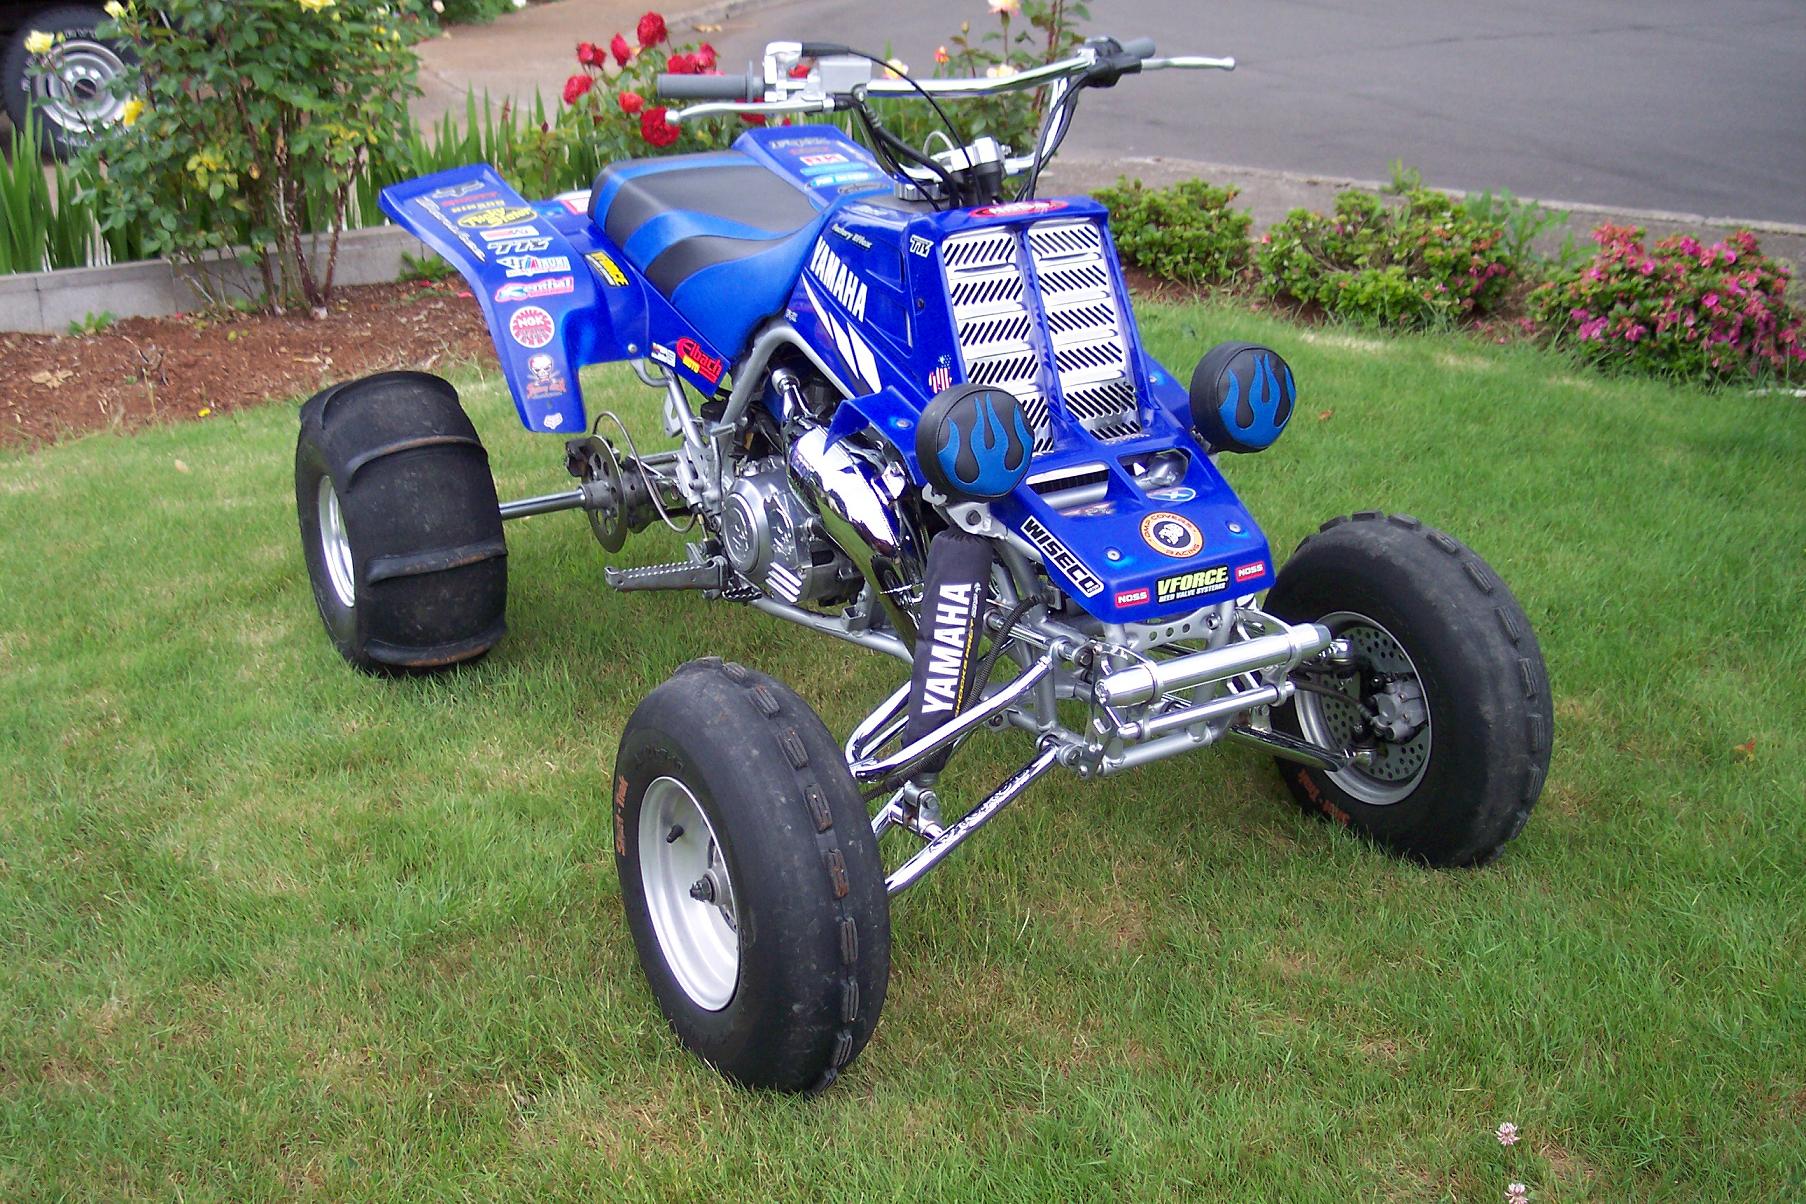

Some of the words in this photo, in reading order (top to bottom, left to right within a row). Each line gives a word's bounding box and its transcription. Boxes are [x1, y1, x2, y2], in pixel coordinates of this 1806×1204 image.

[809, 235, 868, 323] YAMAHA
[517, 316, 545, 328] NGK
[1023, 518, 1101, 593] WISECO
[1157, 566, 1228, 595] VFORCE
[1238, 564, 1264, 577] NOSS
[1117, 591, 1148, 604] NOSS
[1175, 589, 1196, 599] VALVE
[1195, 583, 1226, 595] SYSTEMS
[922, 583, 972, 713] YAMAHA
